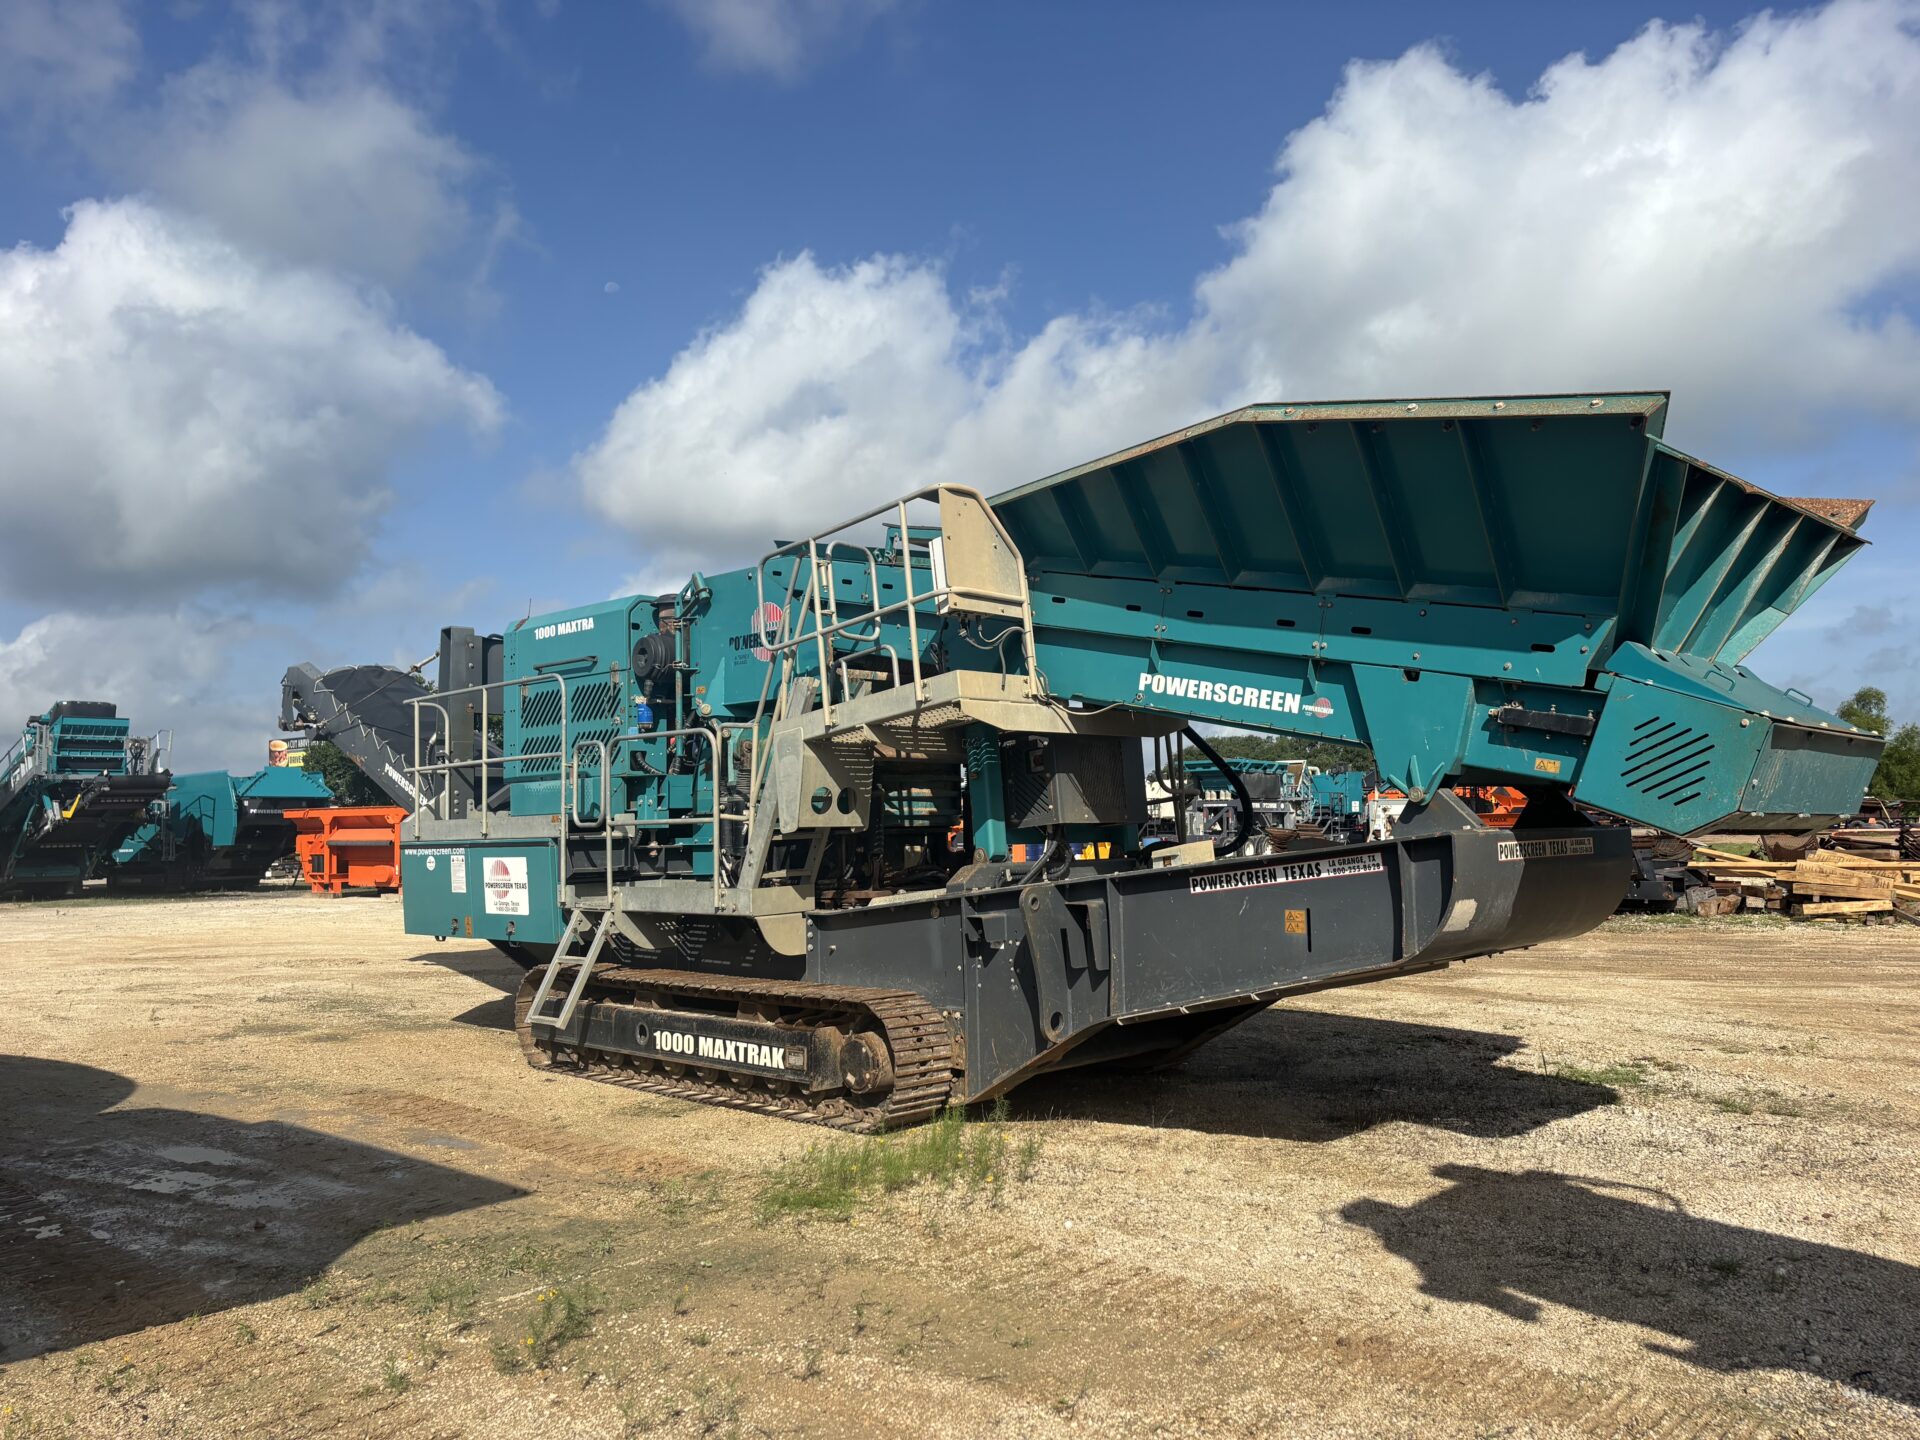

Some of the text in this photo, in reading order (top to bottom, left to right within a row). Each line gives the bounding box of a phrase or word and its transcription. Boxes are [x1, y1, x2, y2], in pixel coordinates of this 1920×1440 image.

[534, 616, 594, 640] 1000 MAXTRA
[1138, 672, 1301, 714] POWERSCREEN
[405, 848, 466, 857] www.powerscreen.com
[1328, 855, 1377, 867] LA GRANGE, TX
[1499, 841, 1547, 860] POWERSCREEN
[1549, 840, 1568, 856] TEXAS
[514, 882, 528, 890] TEXAS
[1192, 862, 1322, 892] POWERSCREEN TEXAS
[653, 1030, 695, 1055] 1000
[698, 1036, 785, 1070] MAXTRAK
